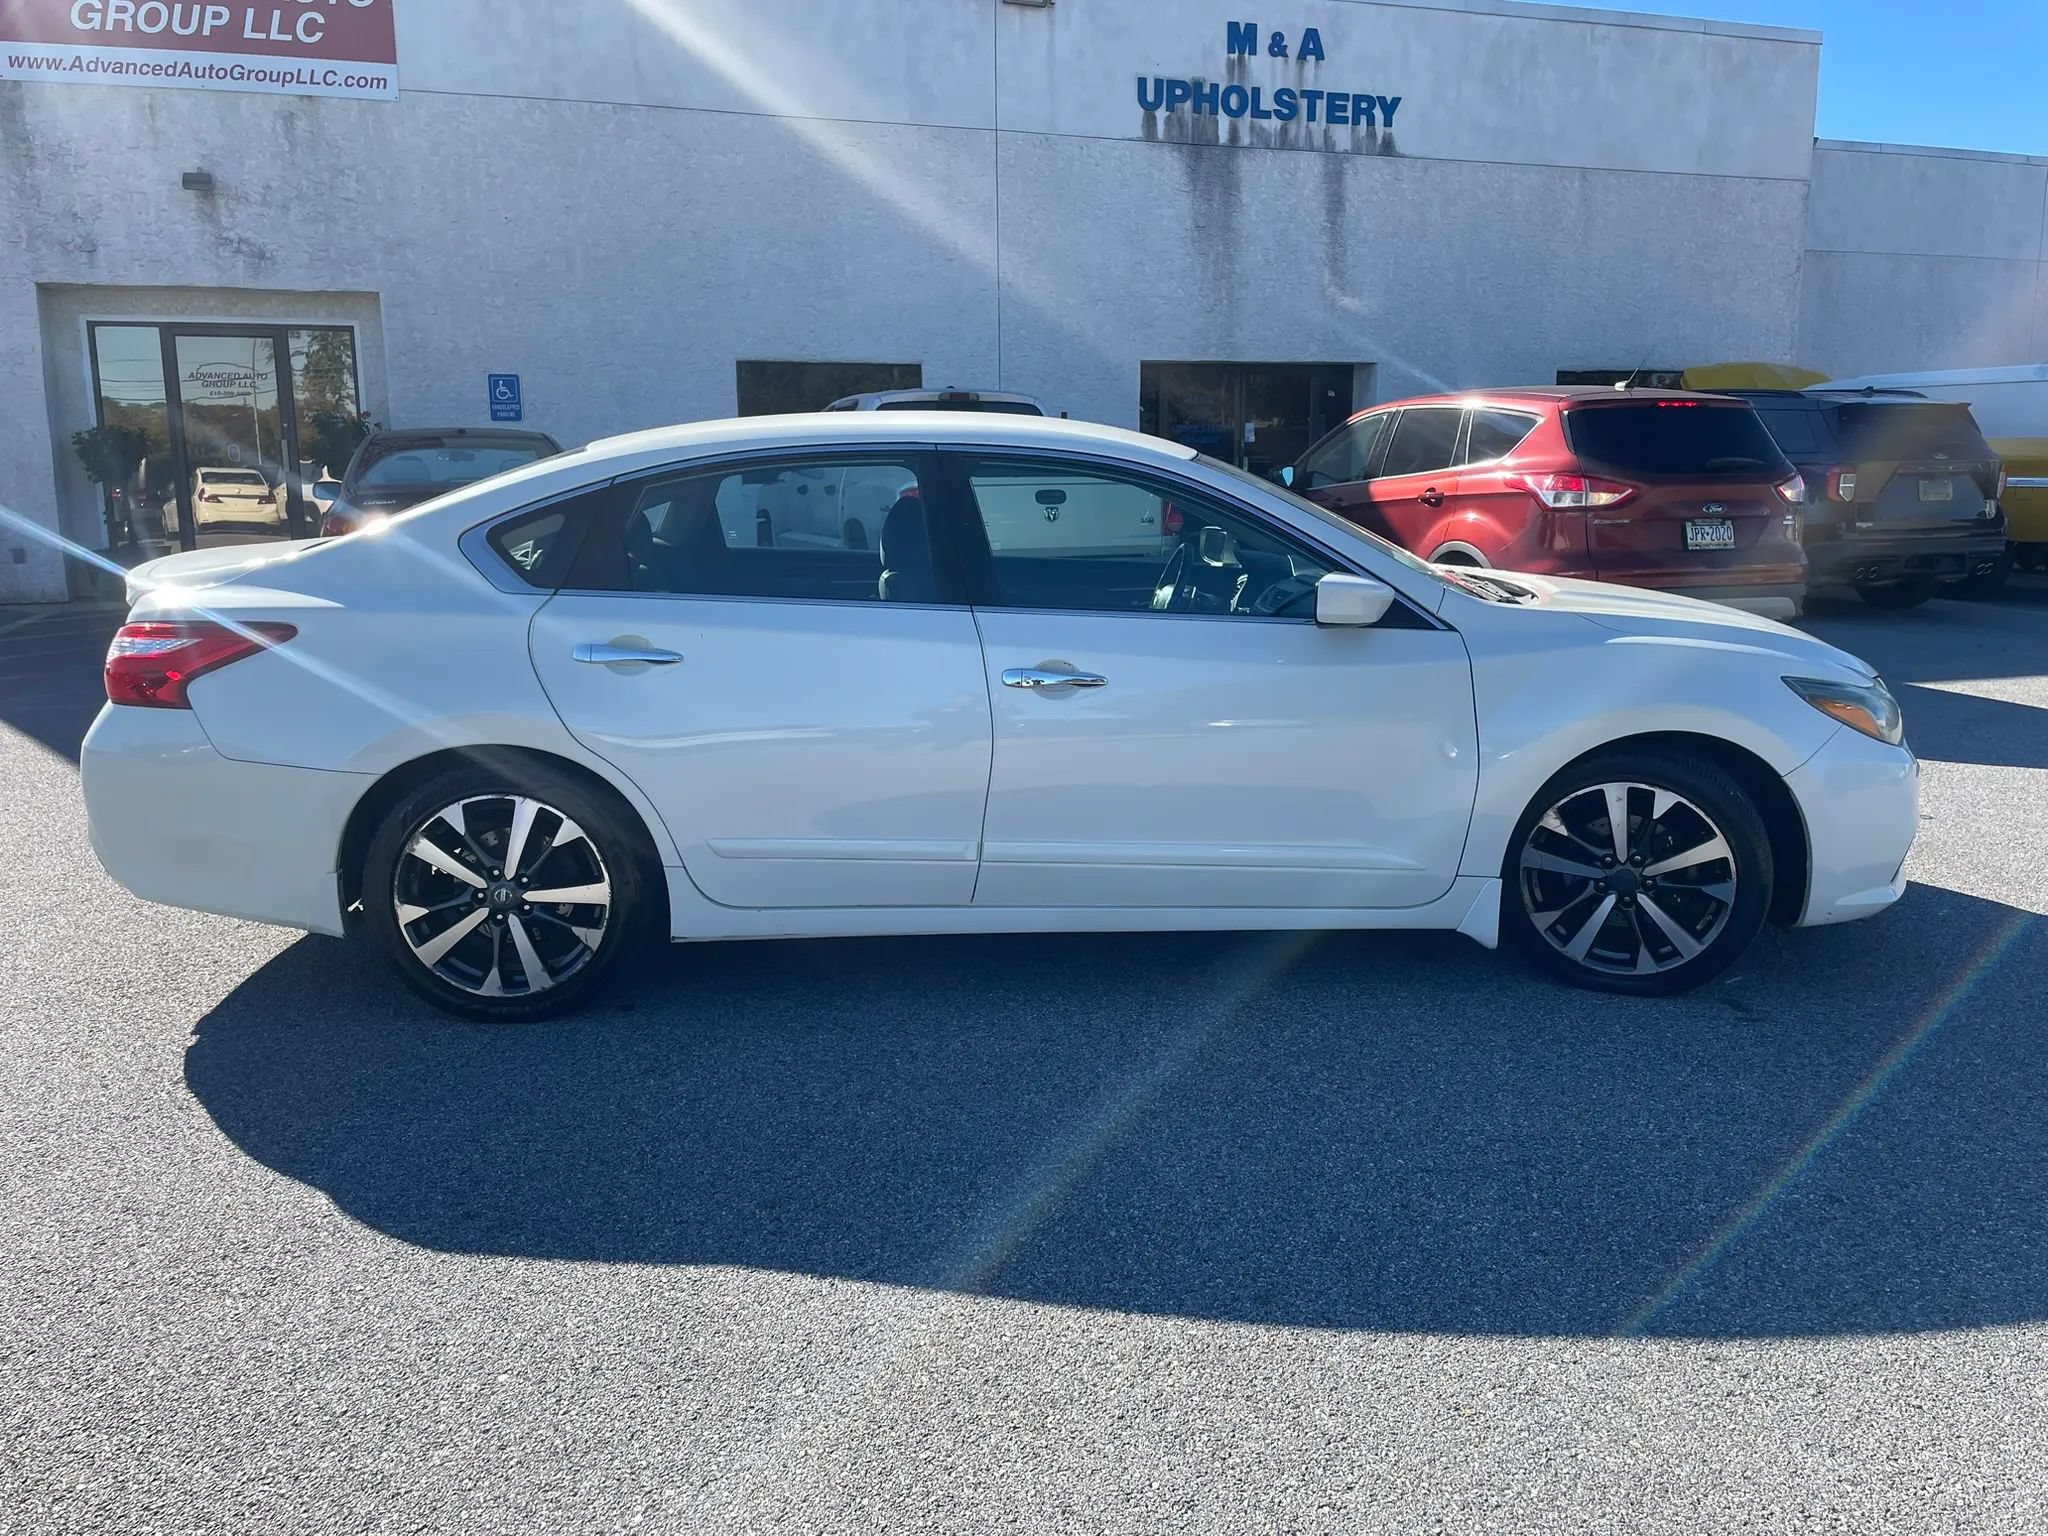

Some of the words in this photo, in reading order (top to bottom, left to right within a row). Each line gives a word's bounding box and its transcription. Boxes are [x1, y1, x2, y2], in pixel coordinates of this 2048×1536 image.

[70, 0, 231, 36] GROUP
[243, 8, 326, 44] LLC
[1227, 21, 1258, 56] M
[1268, 31, 1289, 58] &
[1297, 28, 1326, 61] A
[7, 54, 388, 90] www.AdvancedAutoGroupLLC.com
[1137, 77, 1402, 128] UPHOLSTERY
[188, 372, 242, 380] ADVANCED
[202, 380, 236, 388] GROUP
